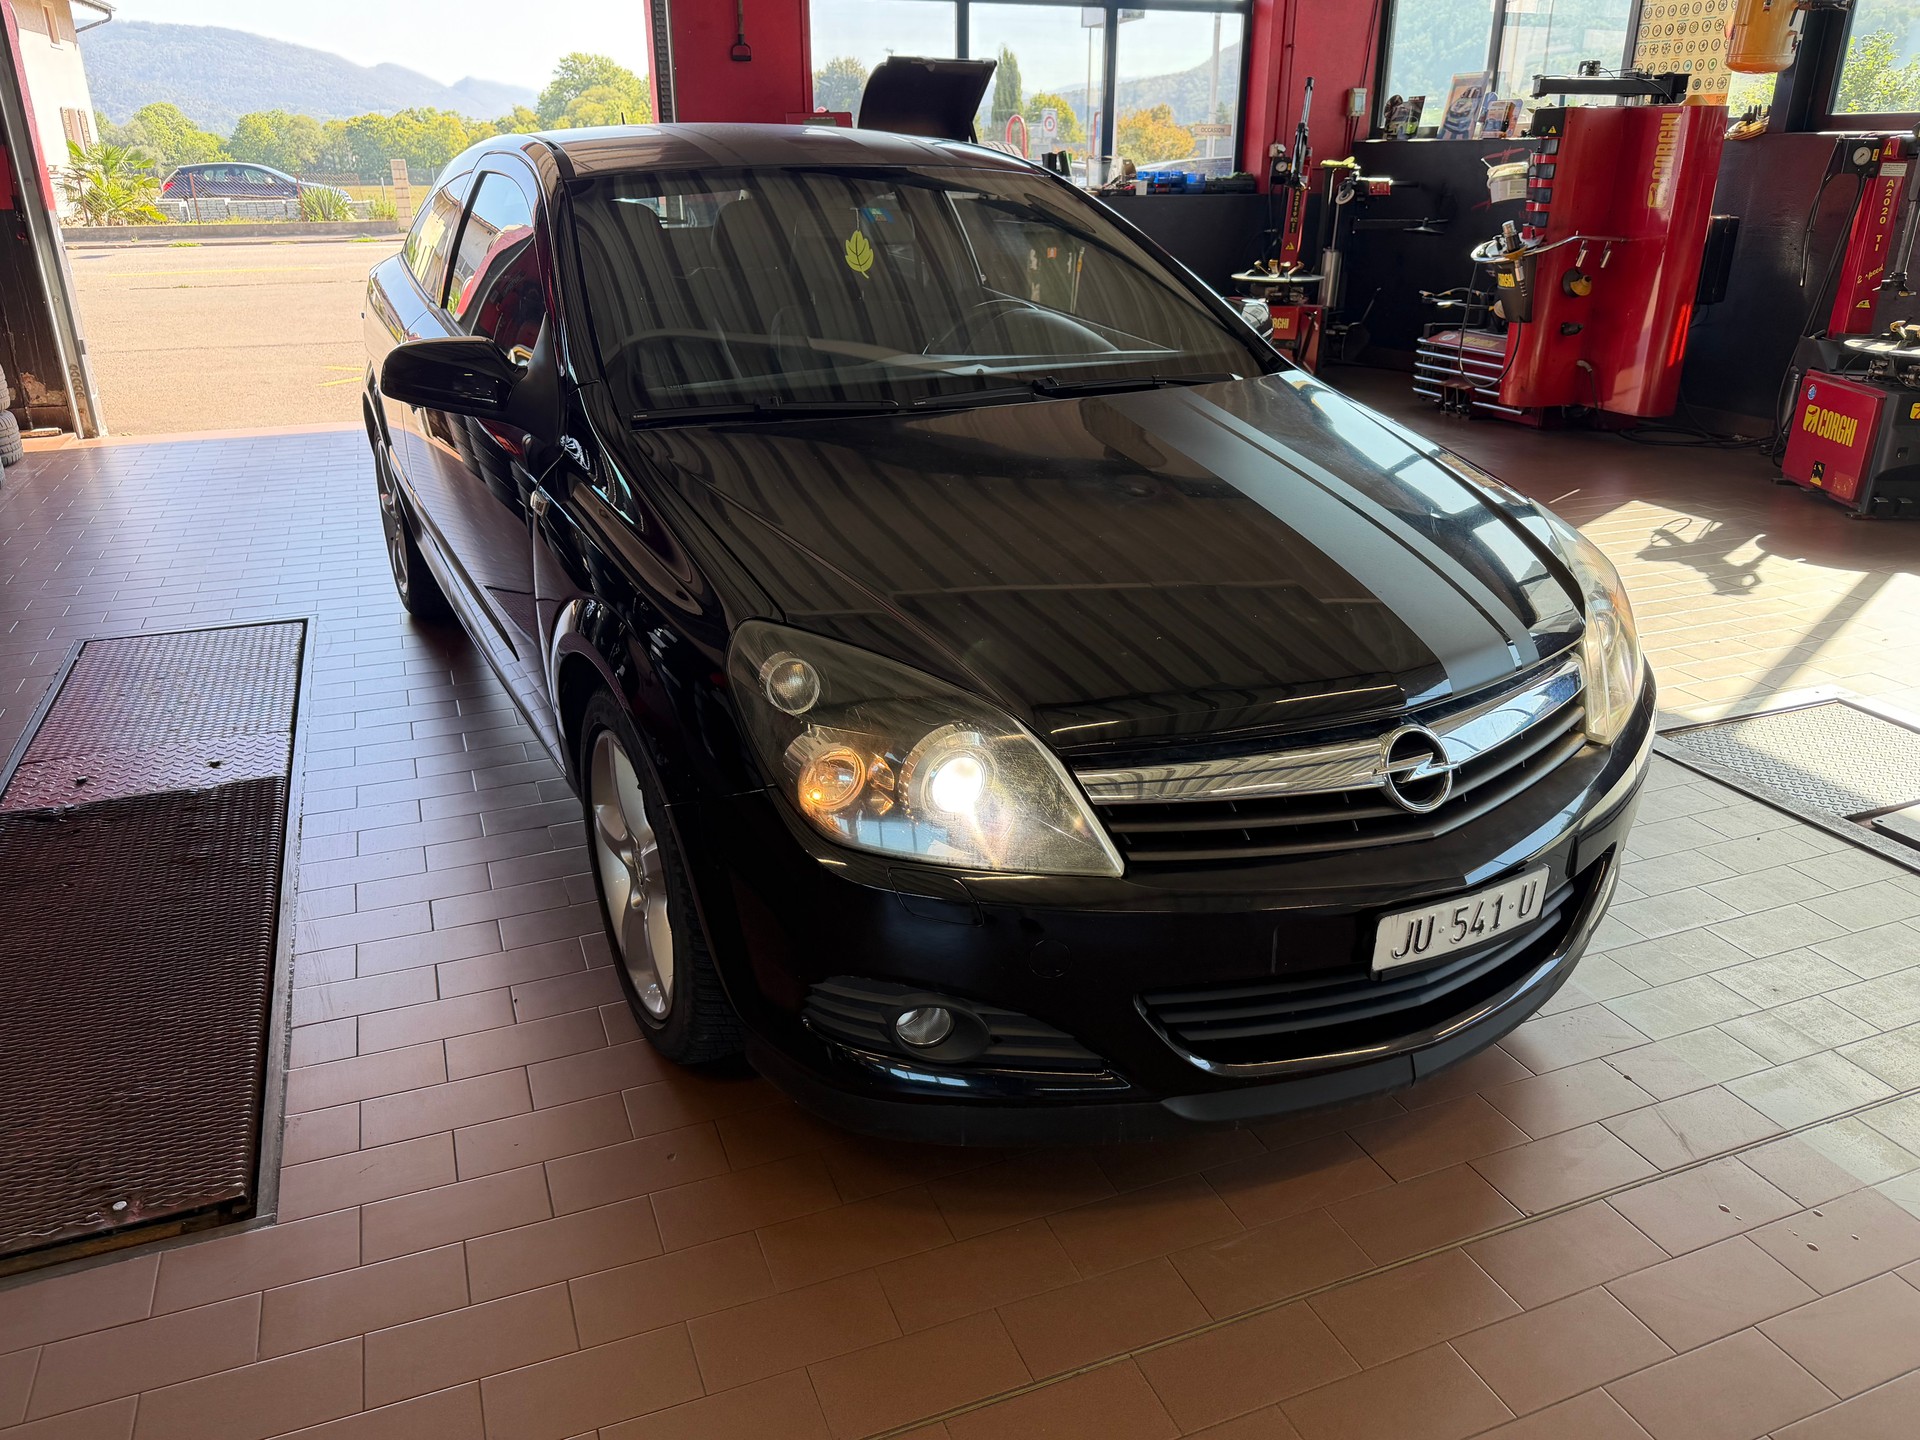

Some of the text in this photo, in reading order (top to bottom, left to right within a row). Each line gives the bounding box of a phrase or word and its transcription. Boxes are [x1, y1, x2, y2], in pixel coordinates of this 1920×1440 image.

[1651, 113, 1682, 180] CORGHI
[1880, 179, 1895, 224] A2020
[1875, 234, 1883, 252] TI
[1272, 317, 1290, 329] RGHI
[1817, 408, 1858, 448] CORGHI
[1391, 878, 1538, 959] JU 541 U
